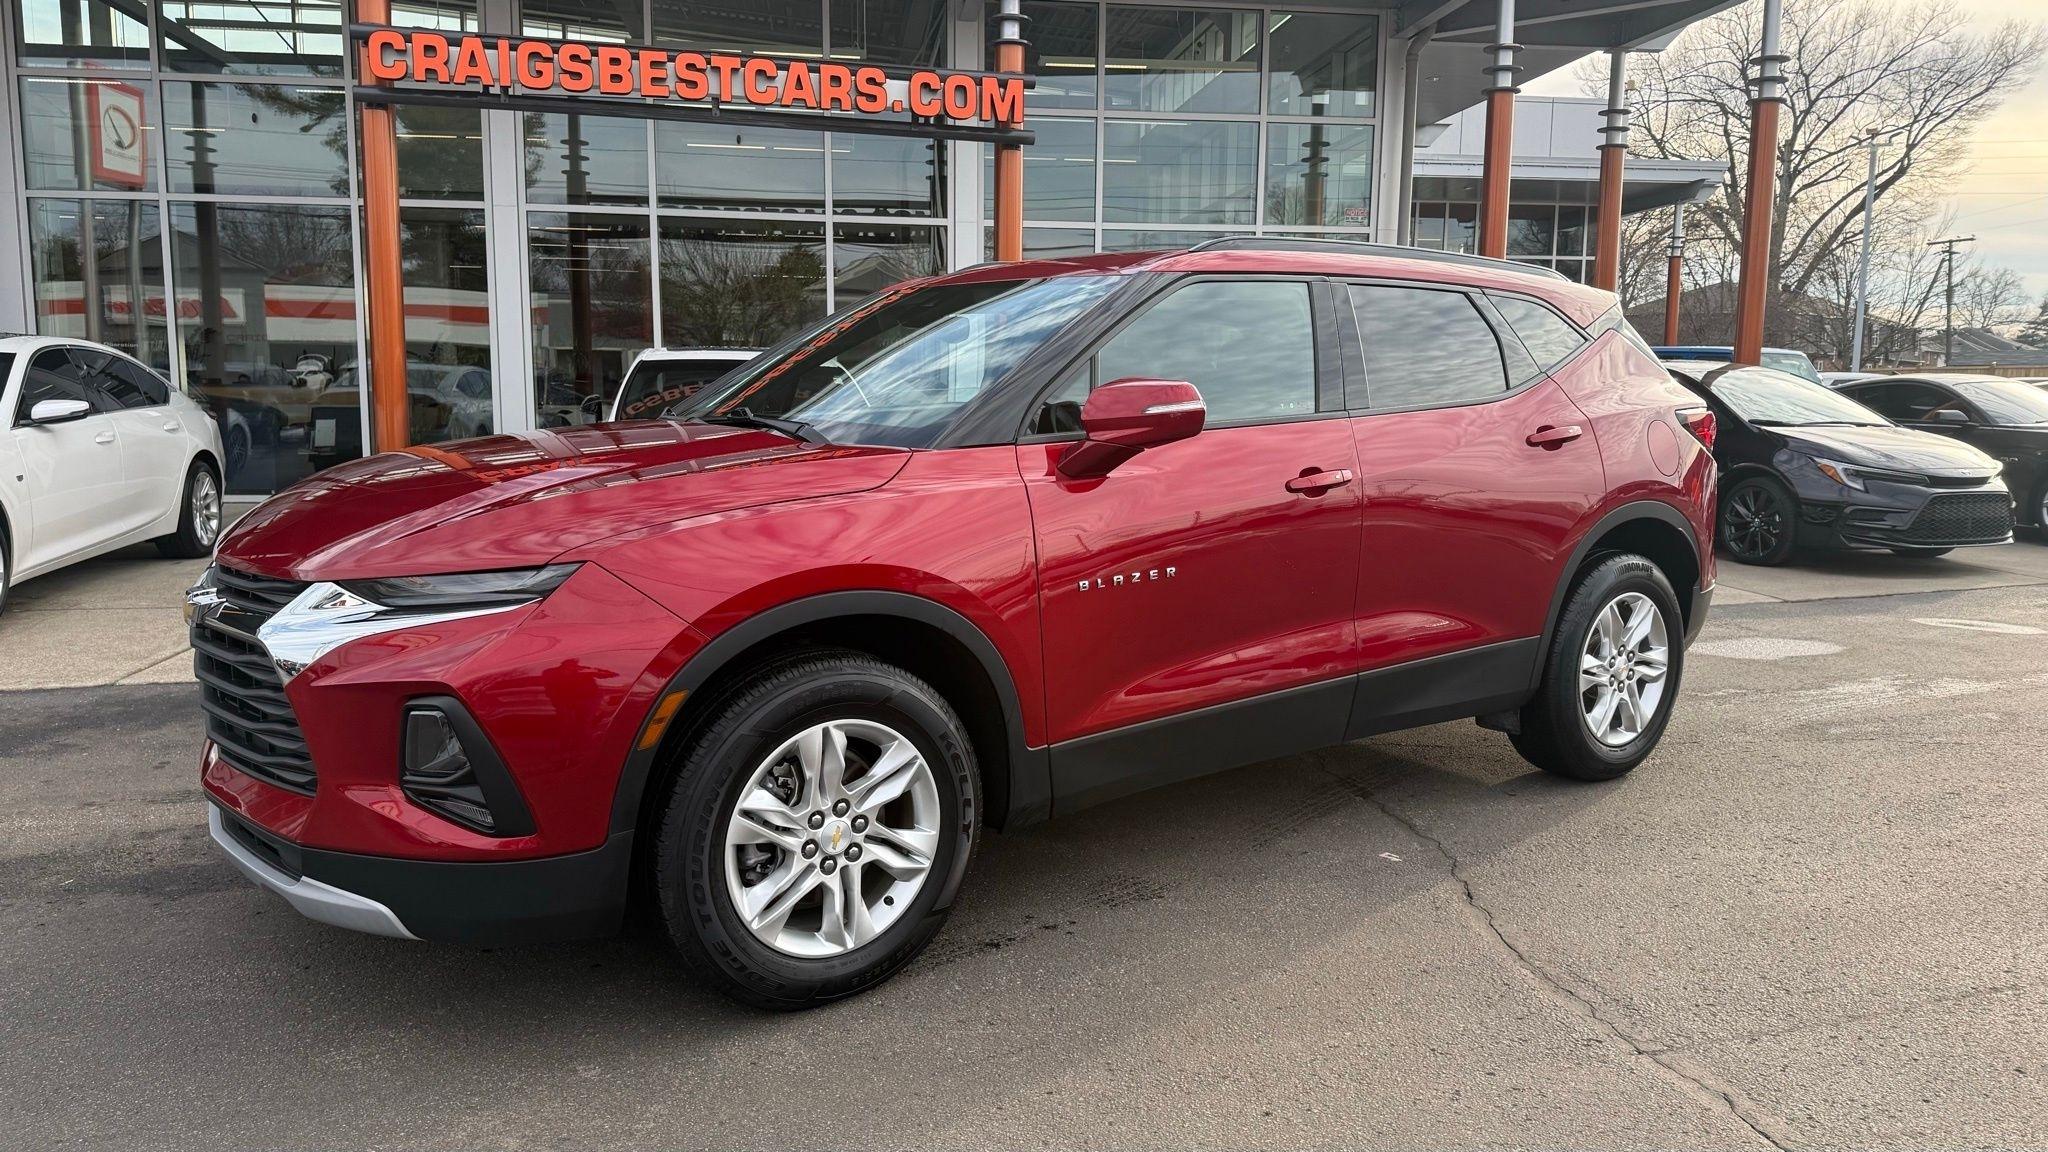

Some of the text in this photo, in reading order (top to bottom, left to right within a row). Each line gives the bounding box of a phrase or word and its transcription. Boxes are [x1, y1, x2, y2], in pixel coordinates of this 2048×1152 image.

[368, 29, 1024, 123] CRAIGSBESTCARS.COM
[1078, 566, 1176, 592] BLAZER
[1621, 562, 1654, 575] MOHAVE
[938, 731, 972, 844] KELLY
